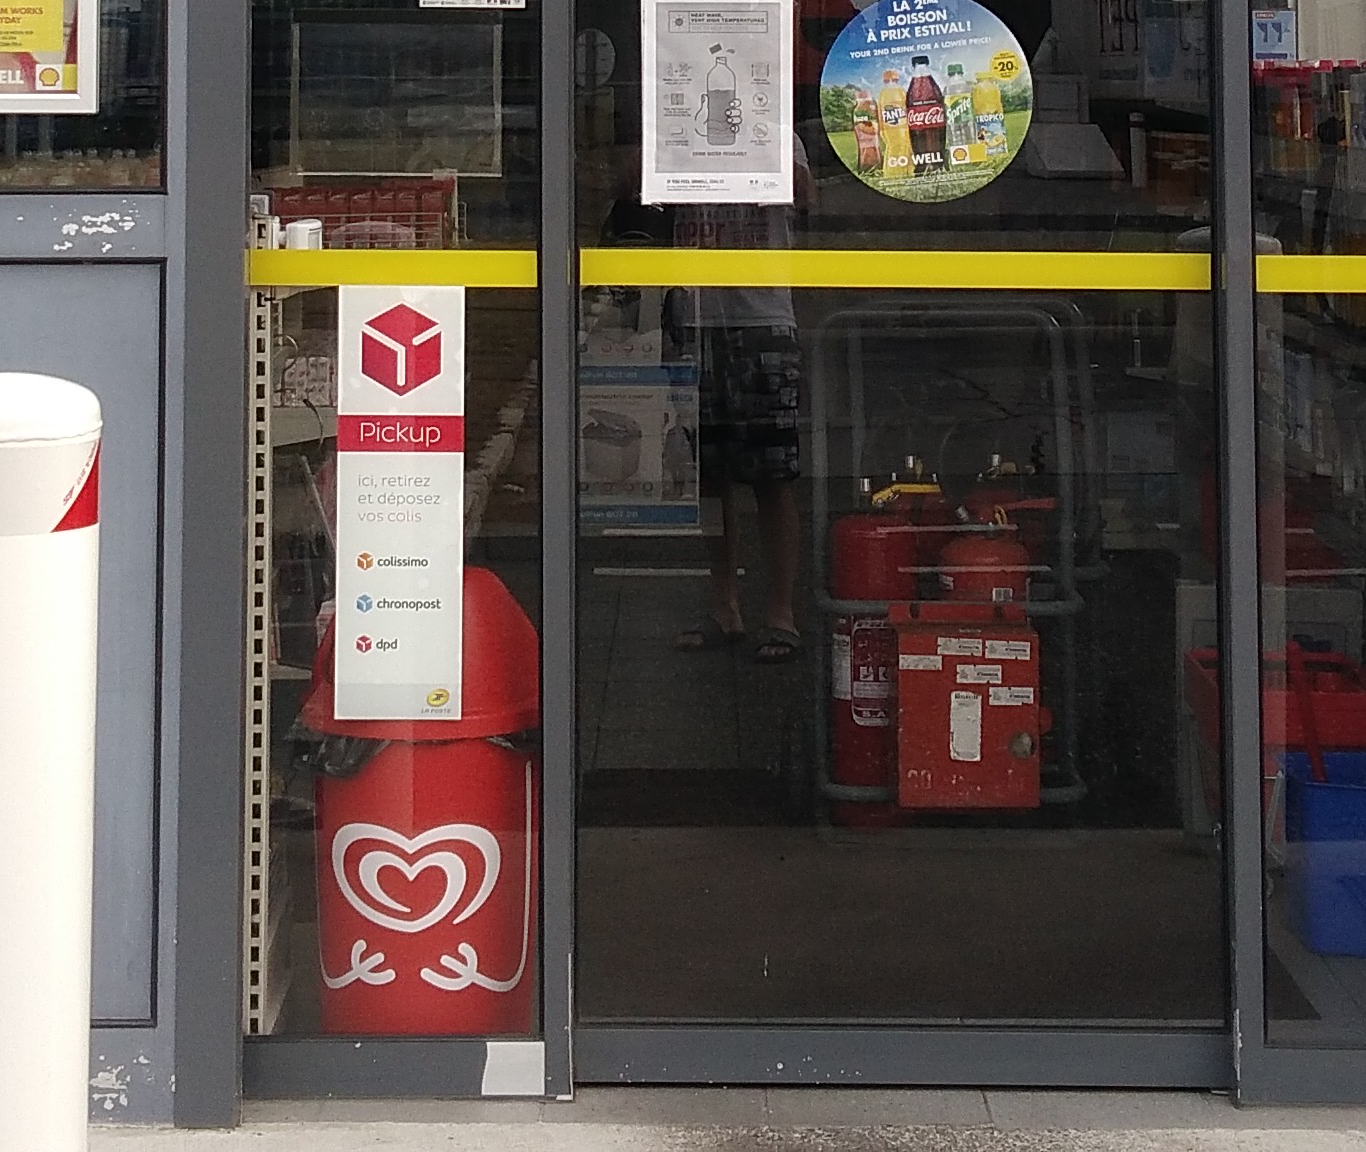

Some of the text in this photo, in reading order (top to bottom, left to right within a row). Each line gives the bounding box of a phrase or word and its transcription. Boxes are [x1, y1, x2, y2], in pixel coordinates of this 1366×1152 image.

[10, 7, 44, 15] WORKS
[892, 0, 910, 13] LA
[887, 9, 948, 27] BOISSON
[866, 28, 877, 44] À
[880, 28, 911, 42] PRIX
[849, 50, 871, 59] YOUR
[873, 48, 889, 56] 2ND
[891, 45, 915, 54] DRINK
[916, 43, 933, 52] FOR
[933, 42, 940, 50] A
[941, 39, 967, 48] LOWER
[946, 97, 972, 125] Sprite
[887, 151, 944, 168] GO WELL
[360, 422, 441, 448] Pickup
[381, 474, 431, 487] retirez
[358, 492, 441, 507] et déposez
[358, 510, 422, 522] vos colis
[377, 555, 429, 568] colissimo
[377, 597, 442, 612] chronopost
[376, 638, 398, 652] dpd
